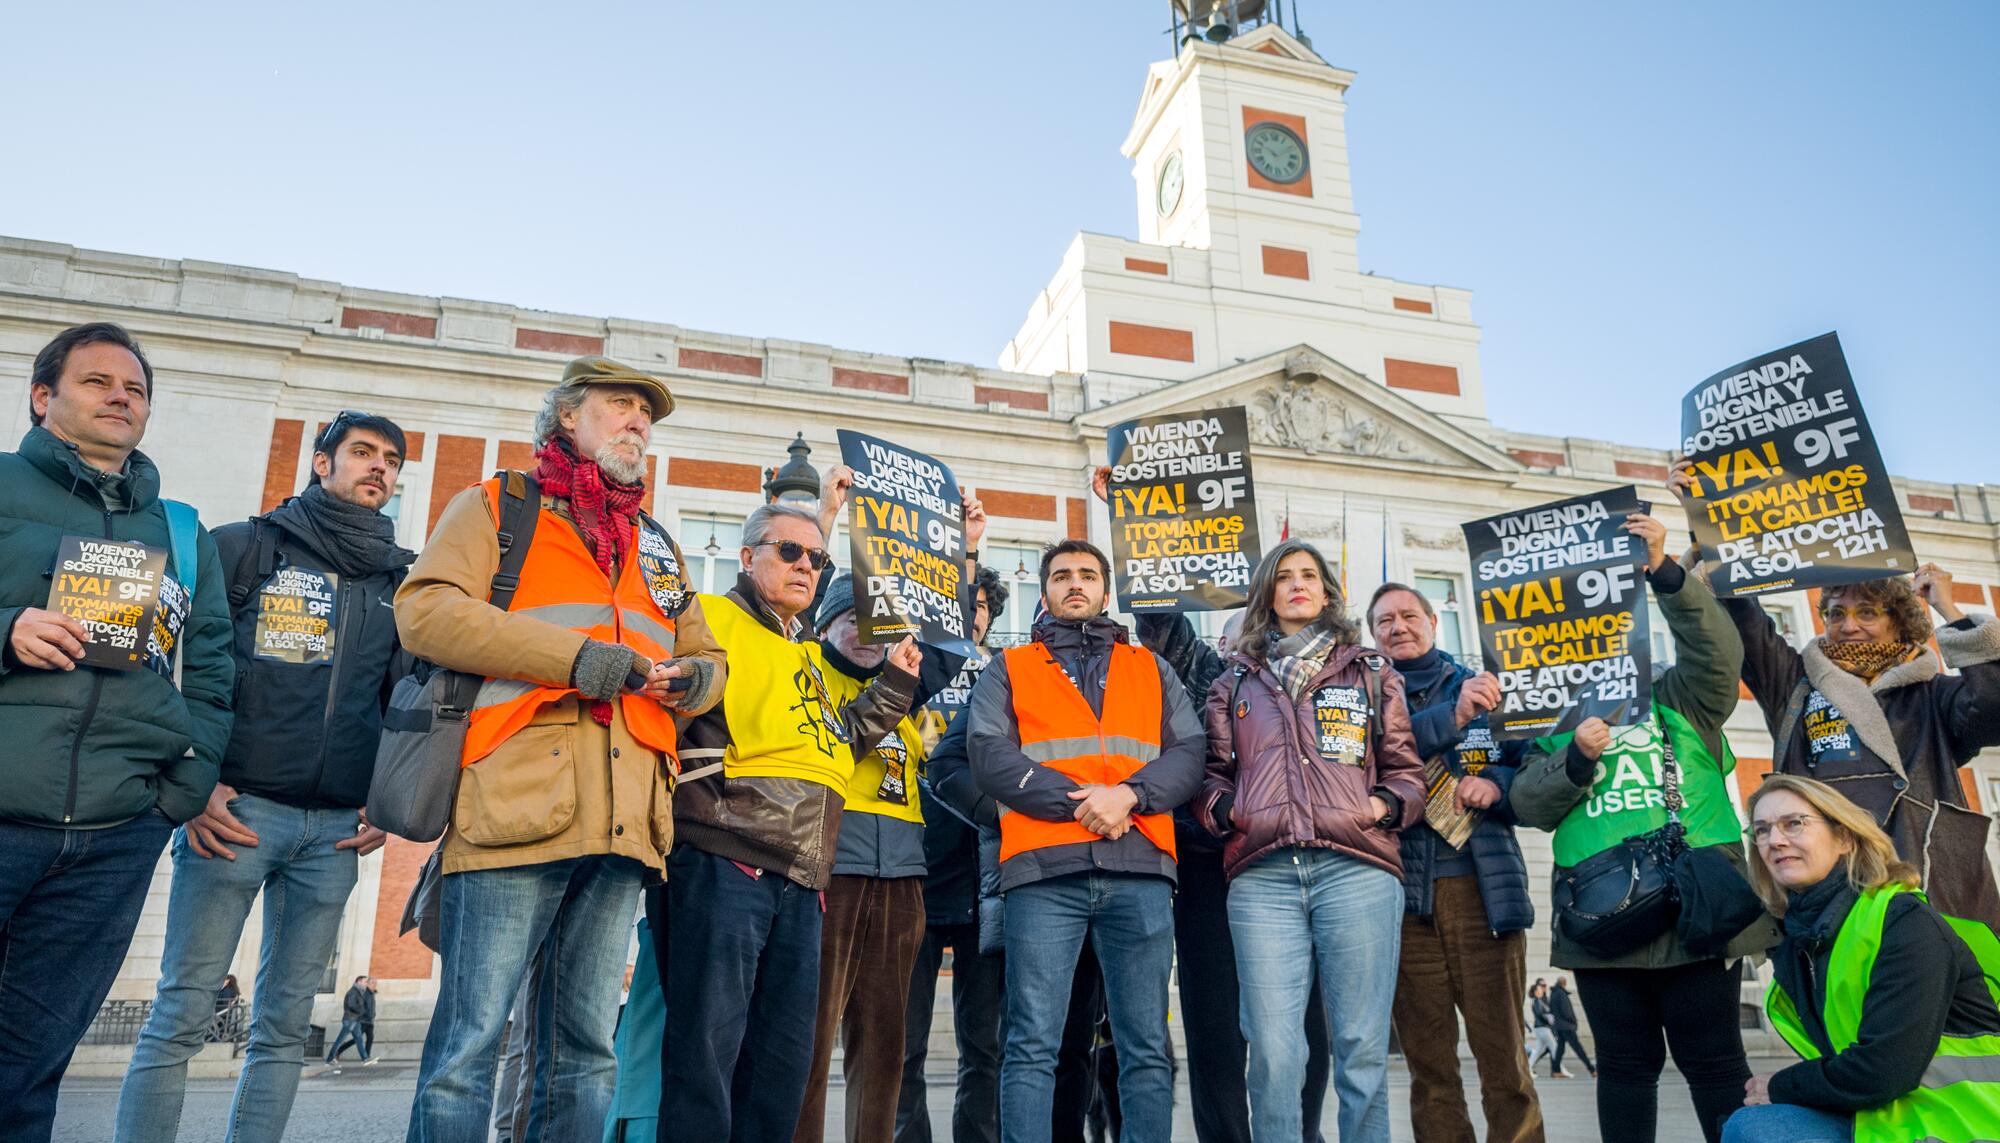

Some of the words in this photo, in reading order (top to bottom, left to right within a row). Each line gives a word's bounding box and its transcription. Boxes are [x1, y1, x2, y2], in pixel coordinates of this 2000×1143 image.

[1694, 354, 1813, 411] VIVIENDA
[1700, 386, 1790, 430] DIGNA
[1784, 376, 1805, 400] Y
[1124, 417, 1224, 445] VIVIENDA
[1683, 389, 1848, 457] SOSTENIBLE
[860, 440, 945, 484] VIVIENDA
[1132, 438, 1200, 462] DIGNA
[1202, 436, 1218, 454] Y
[1684, 441, 1784, 498] ¡YA!
[1794, 417, 1860, 468] 9F
[870, 460, 929, 493] DIGNA
[928, 479, 941, 496] Y
[1112, 452, 1242, 483] SOSTENIBLE
[854, 471, 960, 522] SOSTENIBLE
[1114, 483, 1186, 518] ¡YA!
[1198, 476, 1246, 512] 9F
[1706, 464, 1868, 524] ¡TOMAMOS
[856, 496, 918, 542] ¡YA!
[927, 520, 960, 557] 9F
[1125, 515, 1244, 542] ¡TOMAMOS
[1488, 500, 1610, 537] VIVIENDA
[1718, 515, 1762, 542] LA
[1761, 488, 1866, 531] CALLE!
[80, 541, 147, 560] VIVIENDA
[1132, 540, 1162, 558] LA
[1162, 534, 1240, 556] CALLE!
[1501, 526, 1580, 556] DIGNA
[1582, 521, 1601, 540] Y
[1716, 537, 1759, 563] DE
[1762, 508, 1884, 555] ATOCHA
[63, 560, 154, 582] SOSTENIBLE
[81, 552, 129, 566] DIGNA
[130, 559, 142, 568] Y
[866, 536, 960, 582] ¡TOMAMOS
[1126, 558, 1156, 577] DE
[1158, 552, 1250, 575] ATOCHA
[1478, 536, 1630, 581] SOSTENIBLE
[1730, 562, 1753, 582] A
[1752, 550, 1814, 577] SOL
[1833, 529, 1888, 559] 12H
[58, 574, 112, 597] ¡YA!
[119, 581, 153, 601] 9F
[276, 570, 324, 585] VIVIENDA
[279, 579, 311, 590] DIGNA
[311, 583, 322, 592] Y
[874, 556, 905, 576] LA
[906, 562, 957, 600] CALLE!
[1130, 577, 1148, 594] A
[1150, 574, 1194, 594] SOL
[1210, 568, 1250, 588] 12H
[60, 596, 144, 617] ¡TOMAMOS
[264, 596, 303, 612] ¡YA!
[308, 600, 332, 616] 9F
[266, 586, 332, 602] SOSTENIBLE
[867, 576, 900, 596] DE
[903, 578, 963, 621] ATOCHA
[1480, 576, 1566, 624] ¡YA!
[1576, 564, 1635, 608] 9F
[84, 610, 137, 626] CALLE!
[267, 614, 328, 628] ¡TOMAMOS
[268, 622, 285, 632] LA
[286, 623, 324, 635] CALLE!
[872, 597, 891, 618] A
[893, 596, 932, 622] SOL
[940, 612, 964, 638] 12H
[1494, 612, 1634, 651] ¡TOMAMOS
[110, 636, 136, 649] 12H
[264, 631, 280, 640] DE
[281, 632, 326, 644] ATOCHA
[264, 640, 275, 648] A
[275, 640, 298, 649] SOL
[307, 642, 325, 652] 12H
[1503, 648, 1540, 670] LA
[1540, 634, 1628, 665] CALLE!
[1498, 668, 1534, 692] DE
[1536, 655, 1639, 688] ATOCHA
[1316, 700, 1366, 712] SOSTENIBLE
[1321, 688, 1360, 698] VIVIENDA
[1503, 692, 1524, 714] A
[1524, 685, 1578, 710] SOL
[1596, 677, 1638, 701] 12H
[1318, 708, 1348, 721] ¡YA!
[1350, 712, 1367, 726] 9F
[1586, 788, 1689, 818] USER
